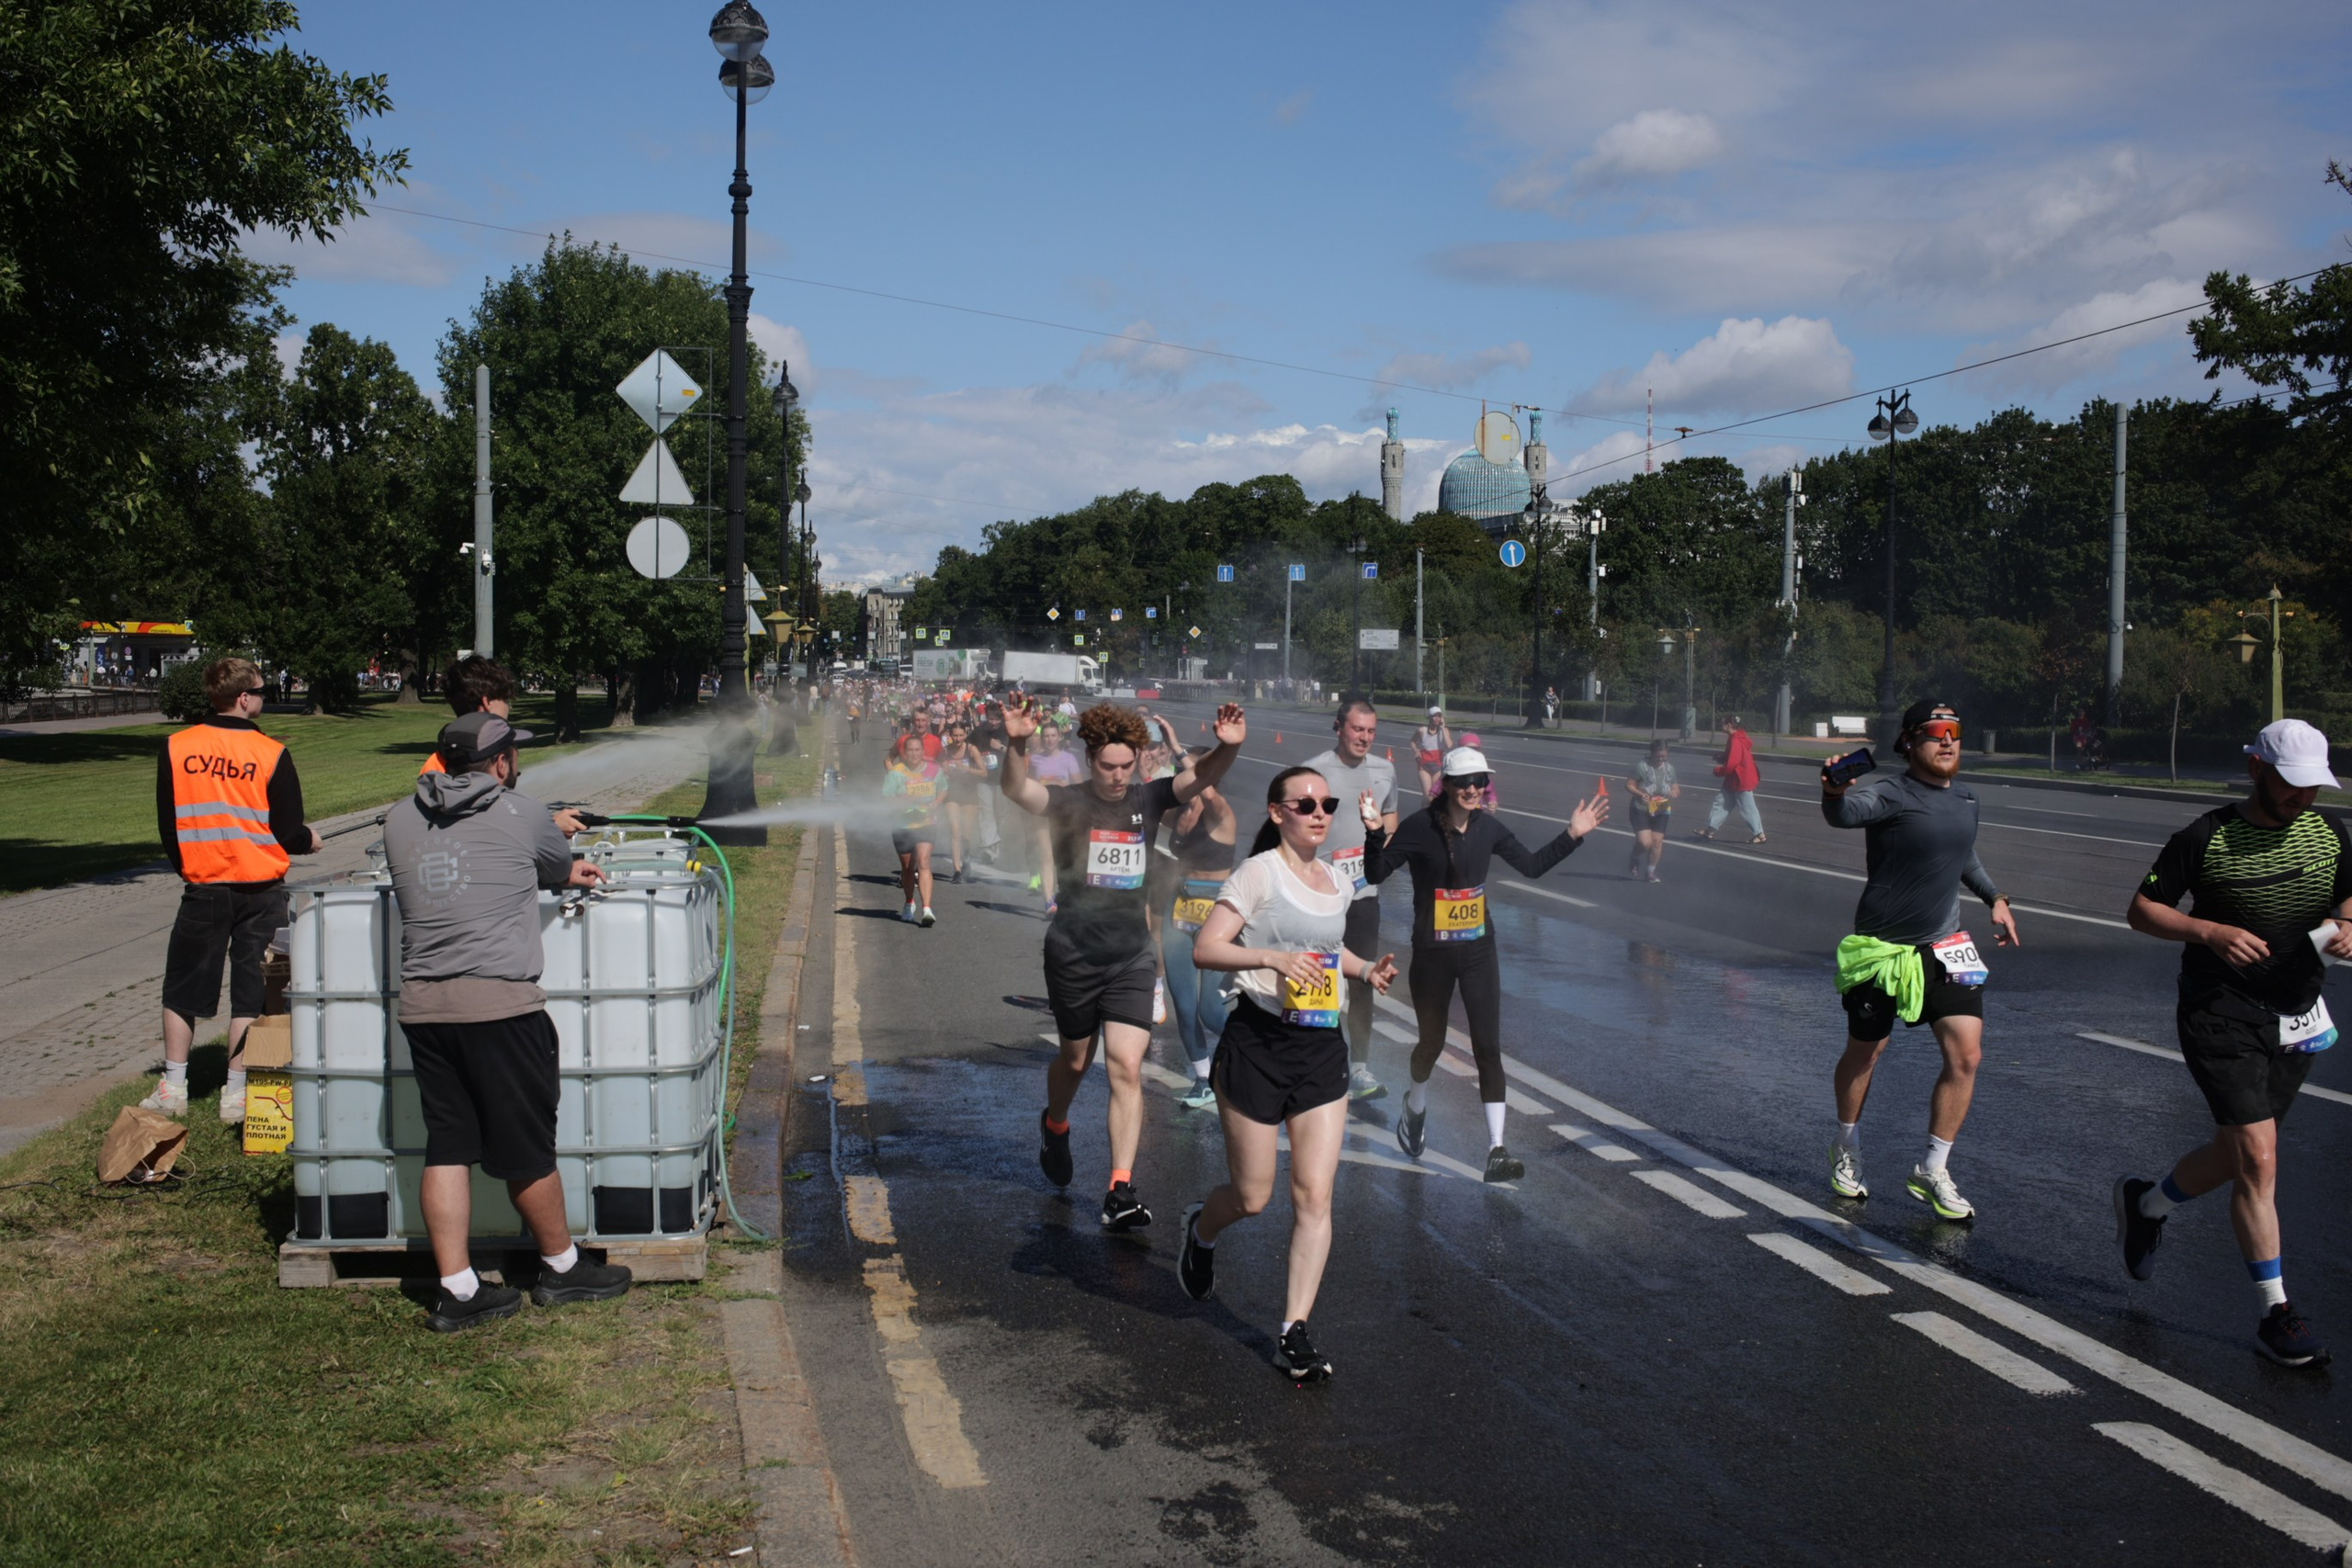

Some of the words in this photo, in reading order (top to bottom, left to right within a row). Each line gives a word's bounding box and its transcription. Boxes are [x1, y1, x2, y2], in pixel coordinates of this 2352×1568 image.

[184, 755, 257, 782] СУДЬЯ
[1097, 847, 1141, 866] 6811
[2302, 857, 2336, 874] SCOTT
[1448, 903, 1478, 920] 408
[1289, 1011, 1299, 1022] E
[246, 1115, 269, 1123] ПЕНА
[246, 1123, 277, 1132] ГУСТАЯ
[246, 1132, 287, 1140] ПЛОТНАЯ
